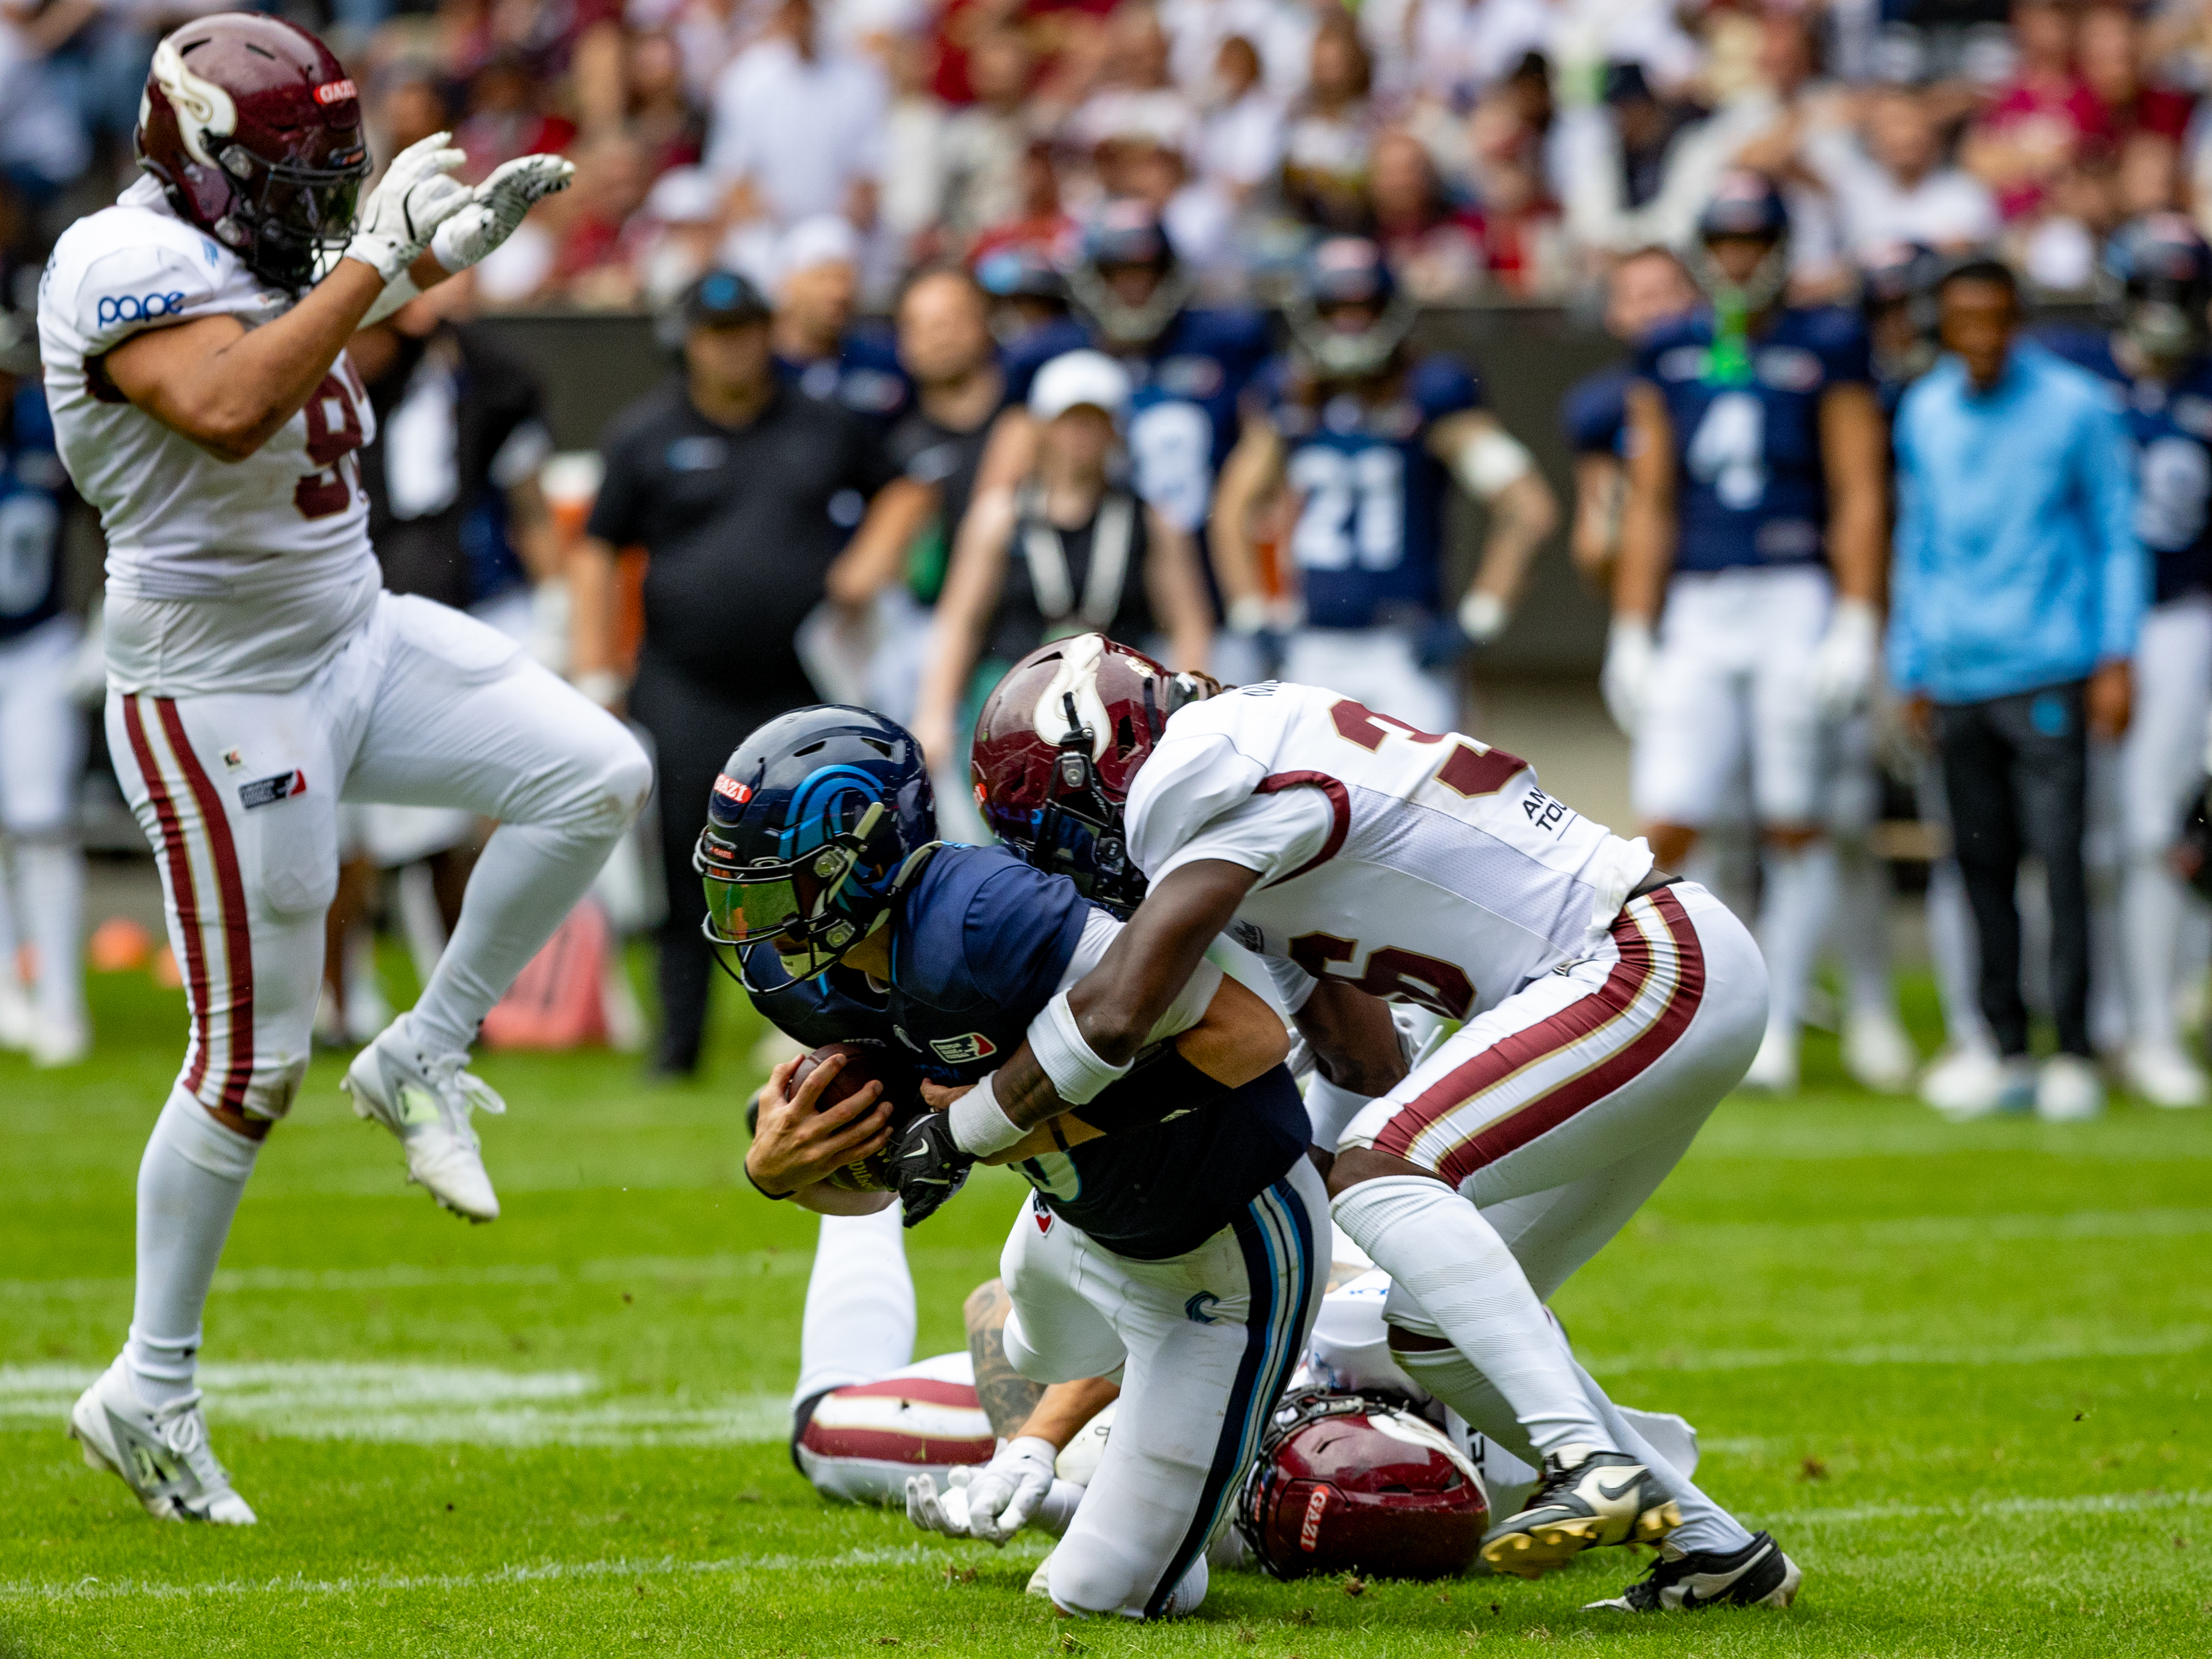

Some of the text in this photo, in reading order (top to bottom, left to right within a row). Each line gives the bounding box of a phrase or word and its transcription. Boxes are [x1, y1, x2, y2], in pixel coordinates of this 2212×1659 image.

[98, 291, 185, 327] pape
[1284, 445, 1406, 571] 21
[1686, 388, 1766, 511] 4
